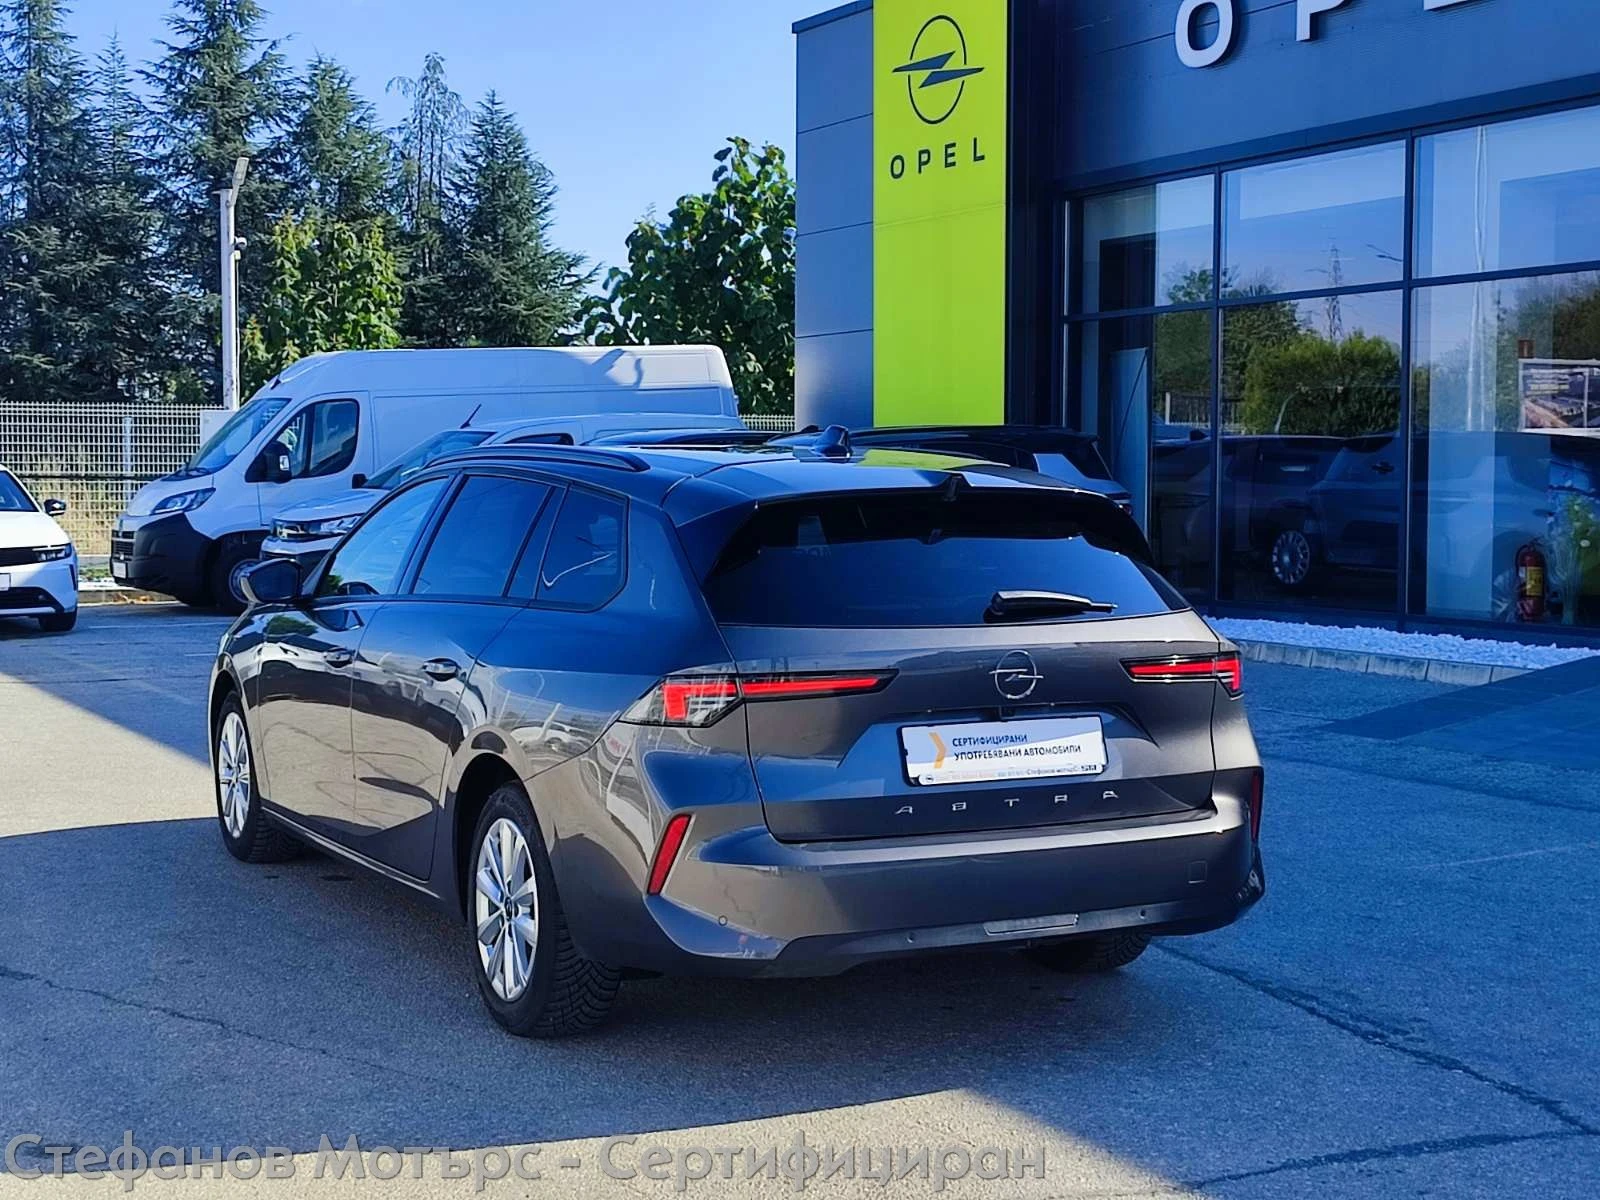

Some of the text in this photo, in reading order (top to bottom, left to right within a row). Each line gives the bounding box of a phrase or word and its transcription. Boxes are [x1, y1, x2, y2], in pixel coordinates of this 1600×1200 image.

[890, 137, 985, 179] OPEL
[952, 734, 1028, 747] СЕРТИФИЦИРАНИ
[954, 744, 1082, 761] УПОТРЕБЯВАНИ АВТОМОБИЛИ
[895, 790, 1119, 815] ASTRA
